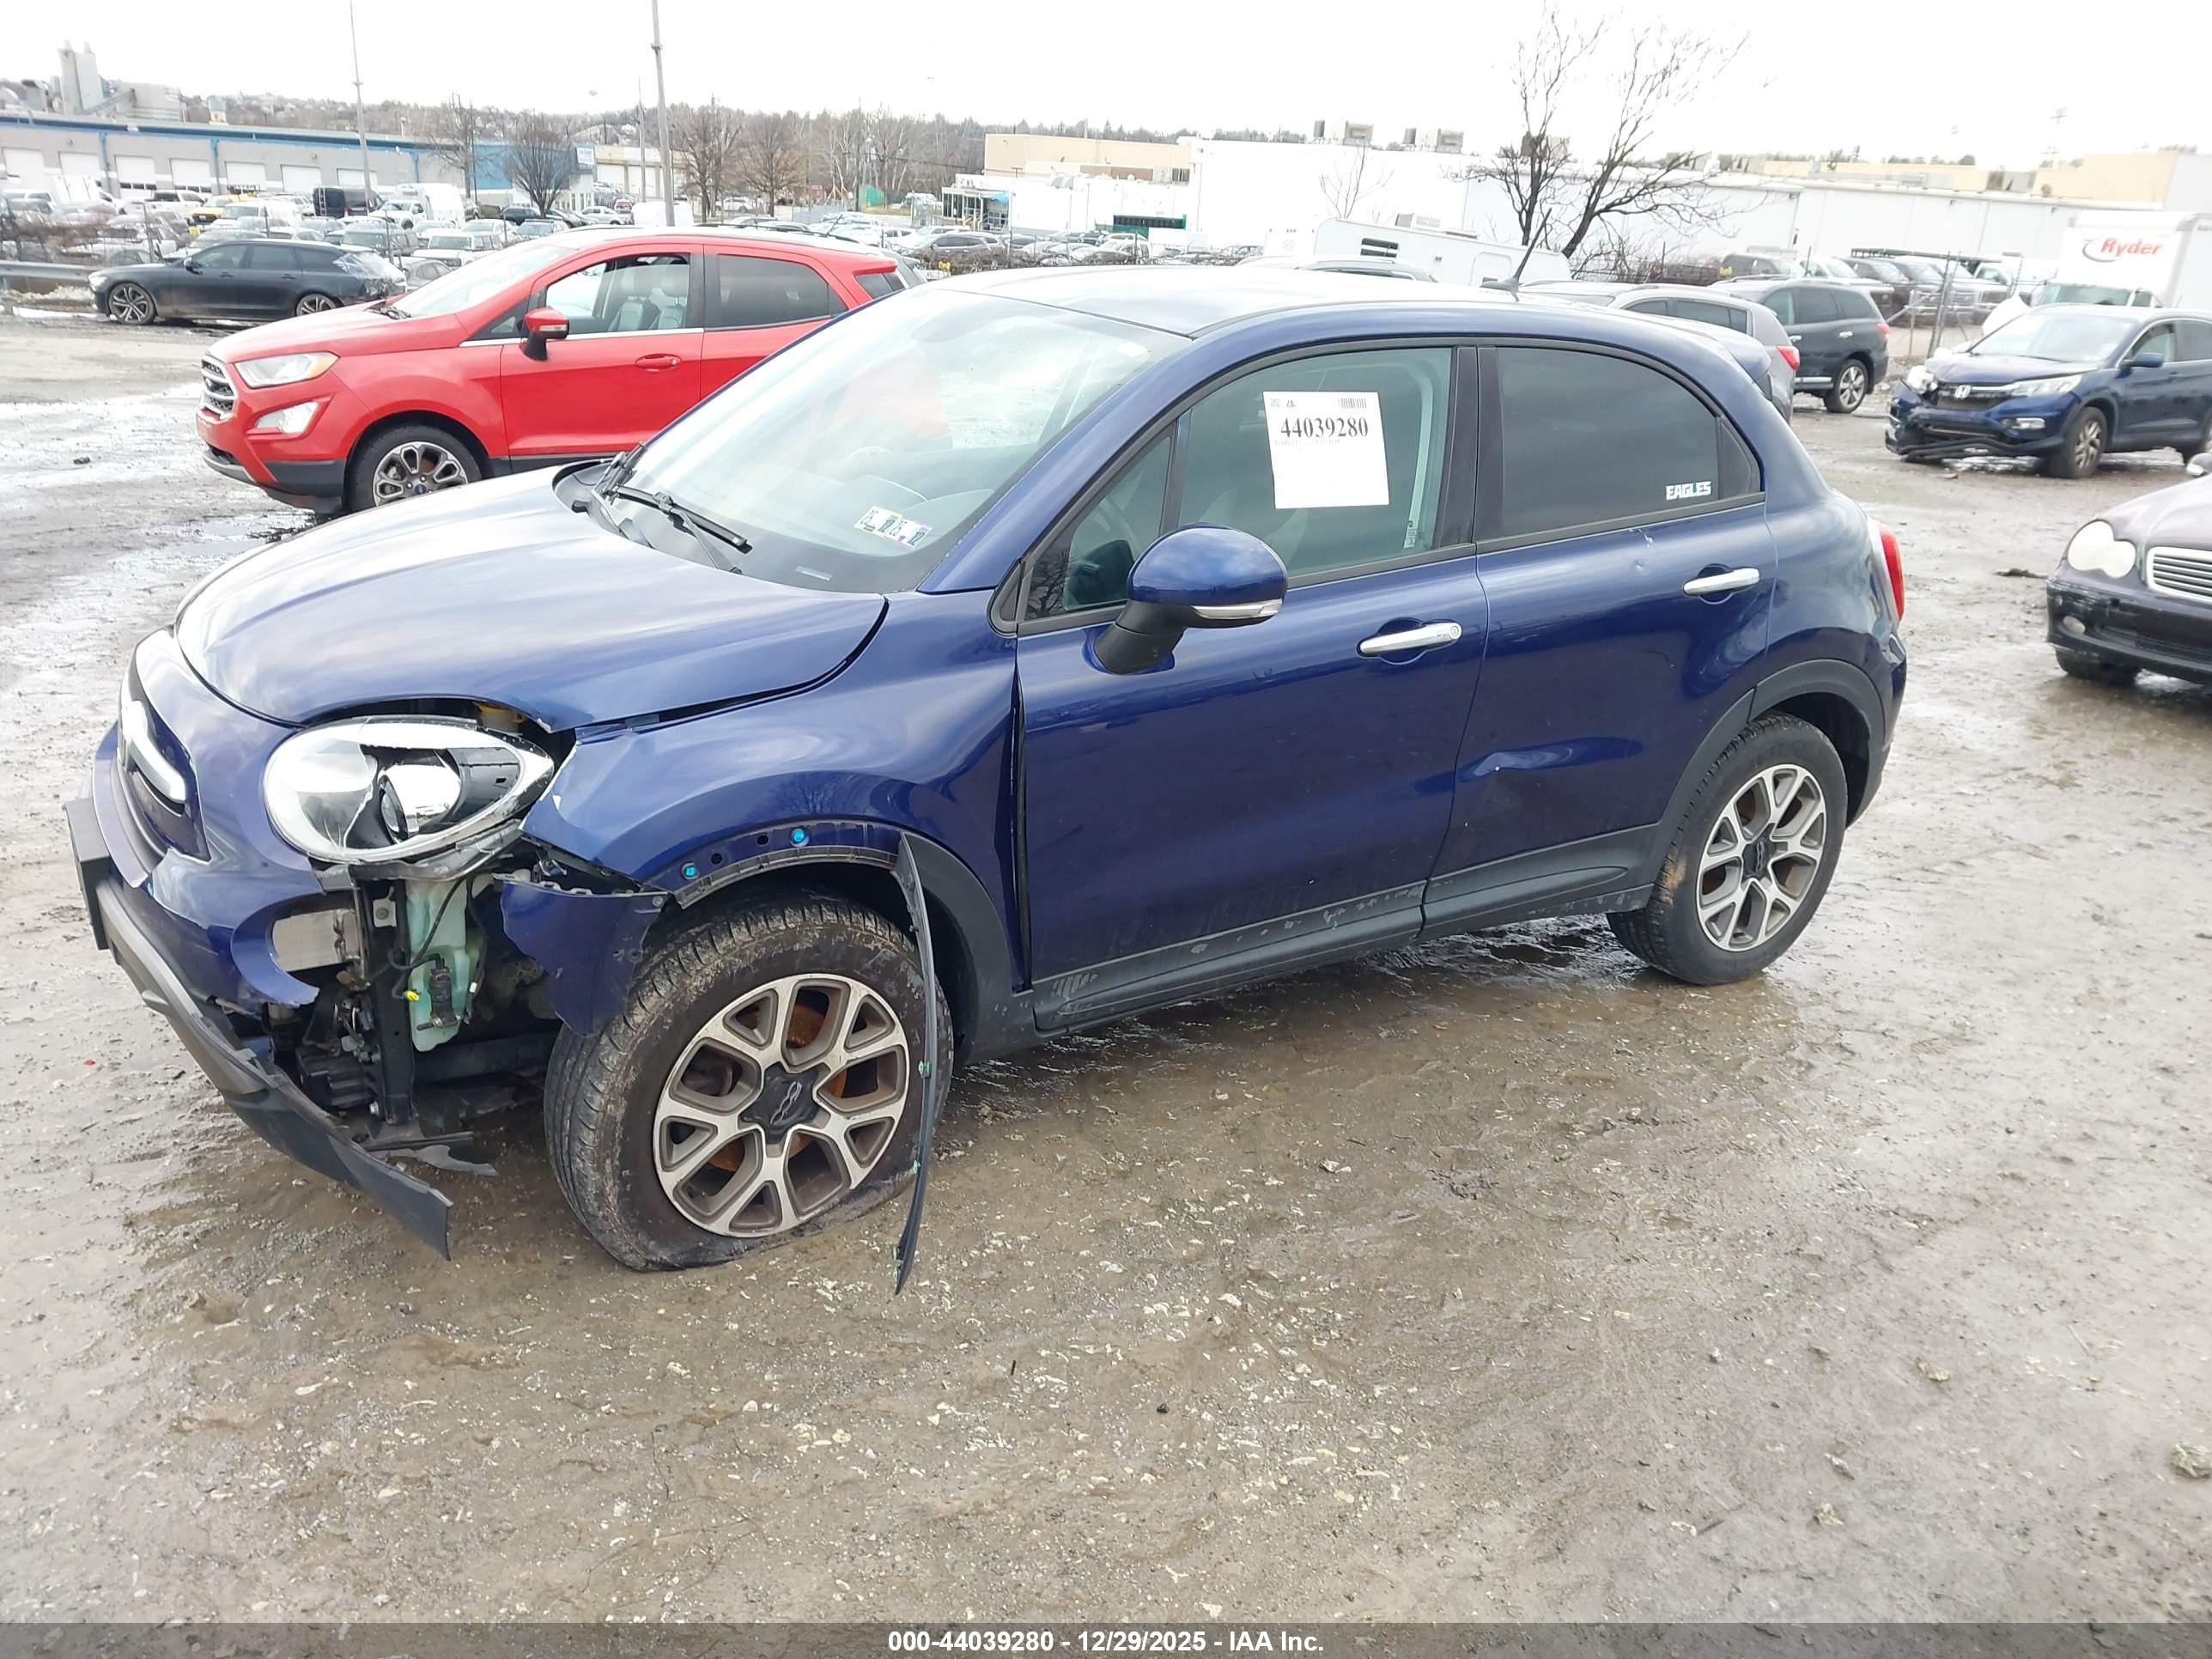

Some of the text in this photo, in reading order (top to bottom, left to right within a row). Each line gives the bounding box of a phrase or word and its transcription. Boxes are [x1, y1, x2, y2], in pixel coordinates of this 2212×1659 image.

[2100, 237, 2163, 257] Ryder
[1280, 416, 1369, 438] 44039280
[1665, 481, 1711, 501] EAGLES
